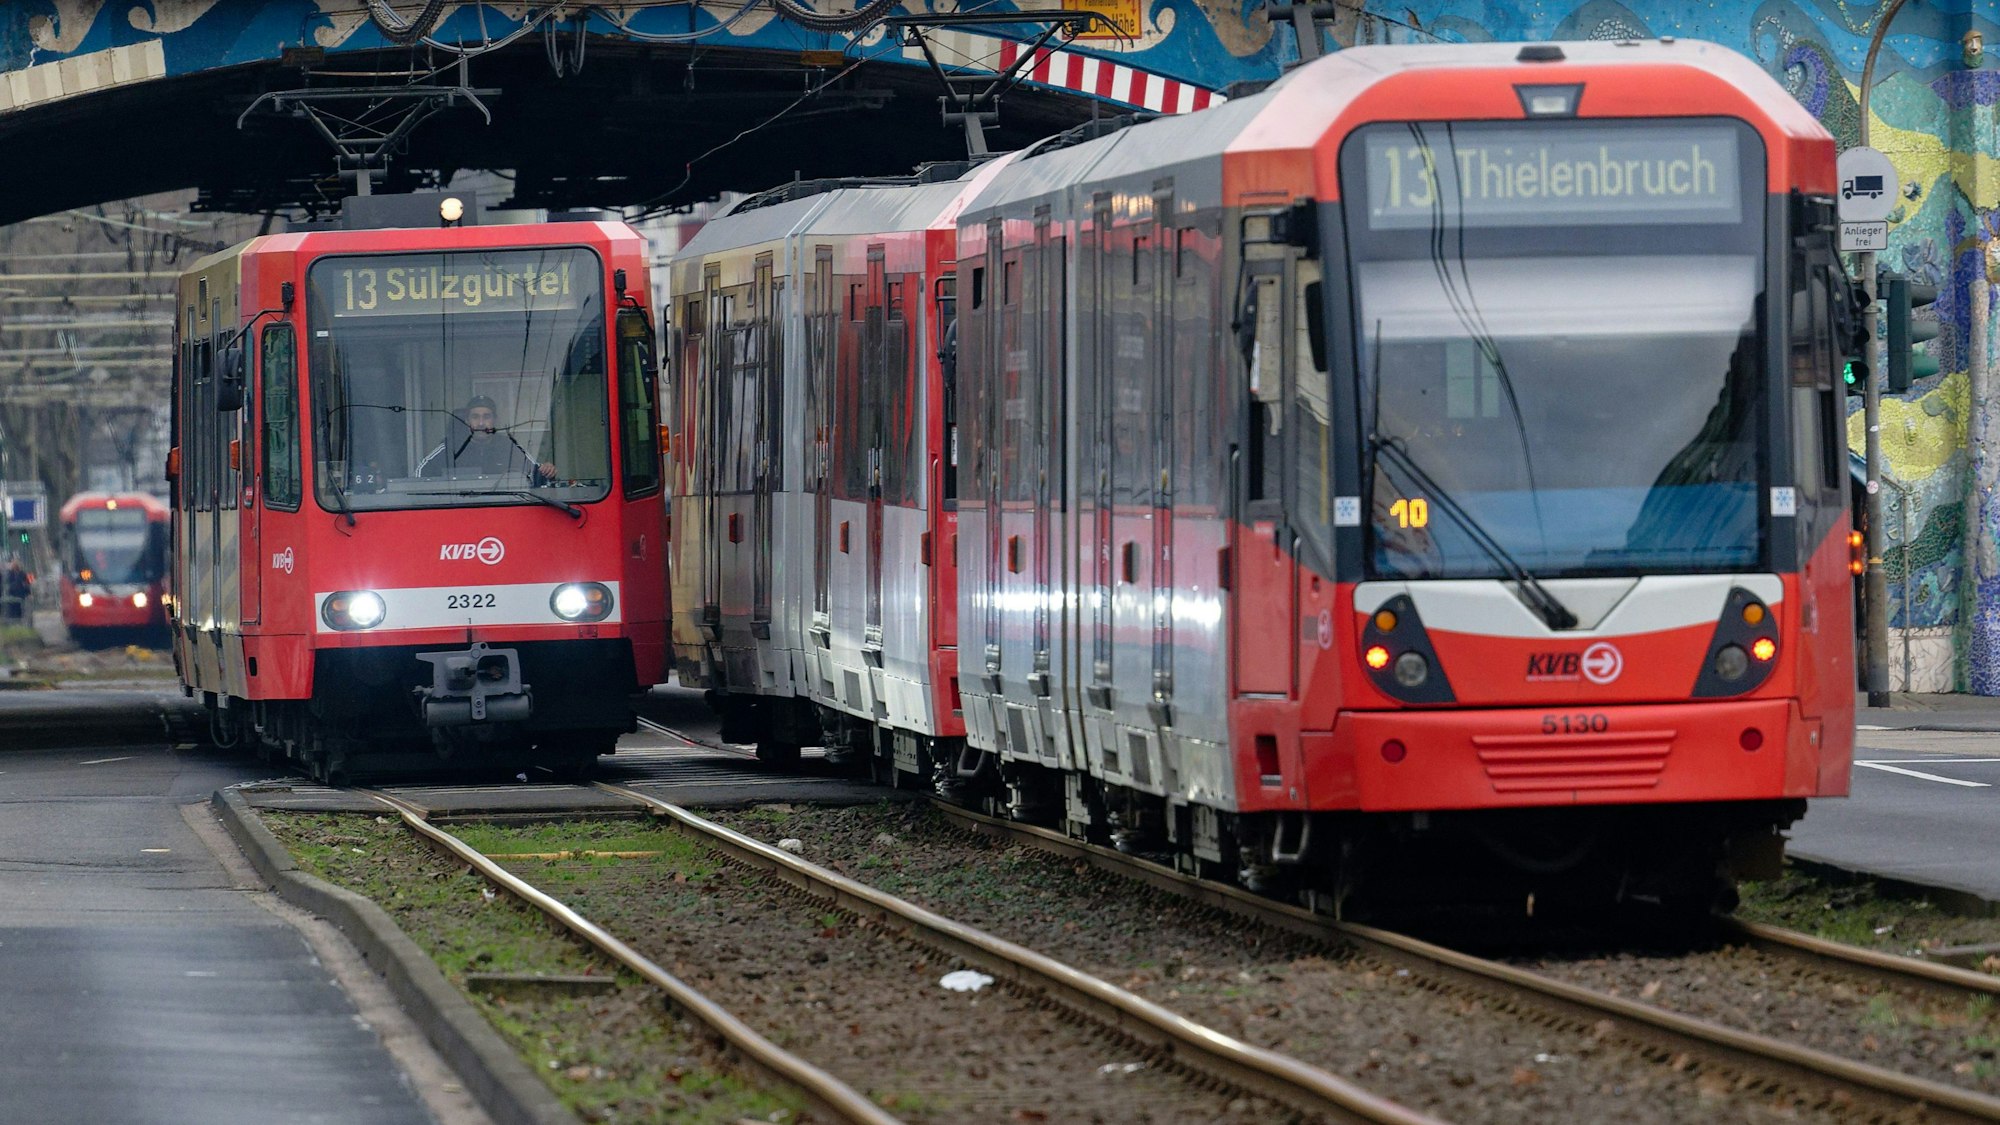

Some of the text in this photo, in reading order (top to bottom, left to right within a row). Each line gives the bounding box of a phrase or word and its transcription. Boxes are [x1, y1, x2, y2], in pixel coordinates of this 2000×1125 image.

[1384, 144, 1716, 208] 13 Thielenbruch
[1844, 227, 1883, 237] Anlieger
[1855, 238, 1872, 246] frei
[343, 262, 569, 310] 13 Sülzgürtel
[1389, 498, 1428, 528] 10
[440, 543, 477, 560] KVB
[447, 593, 496, 609] 2322
[1526, 651, 1580, 676] KVB
[1541, 713, 1609, 735] 5130
